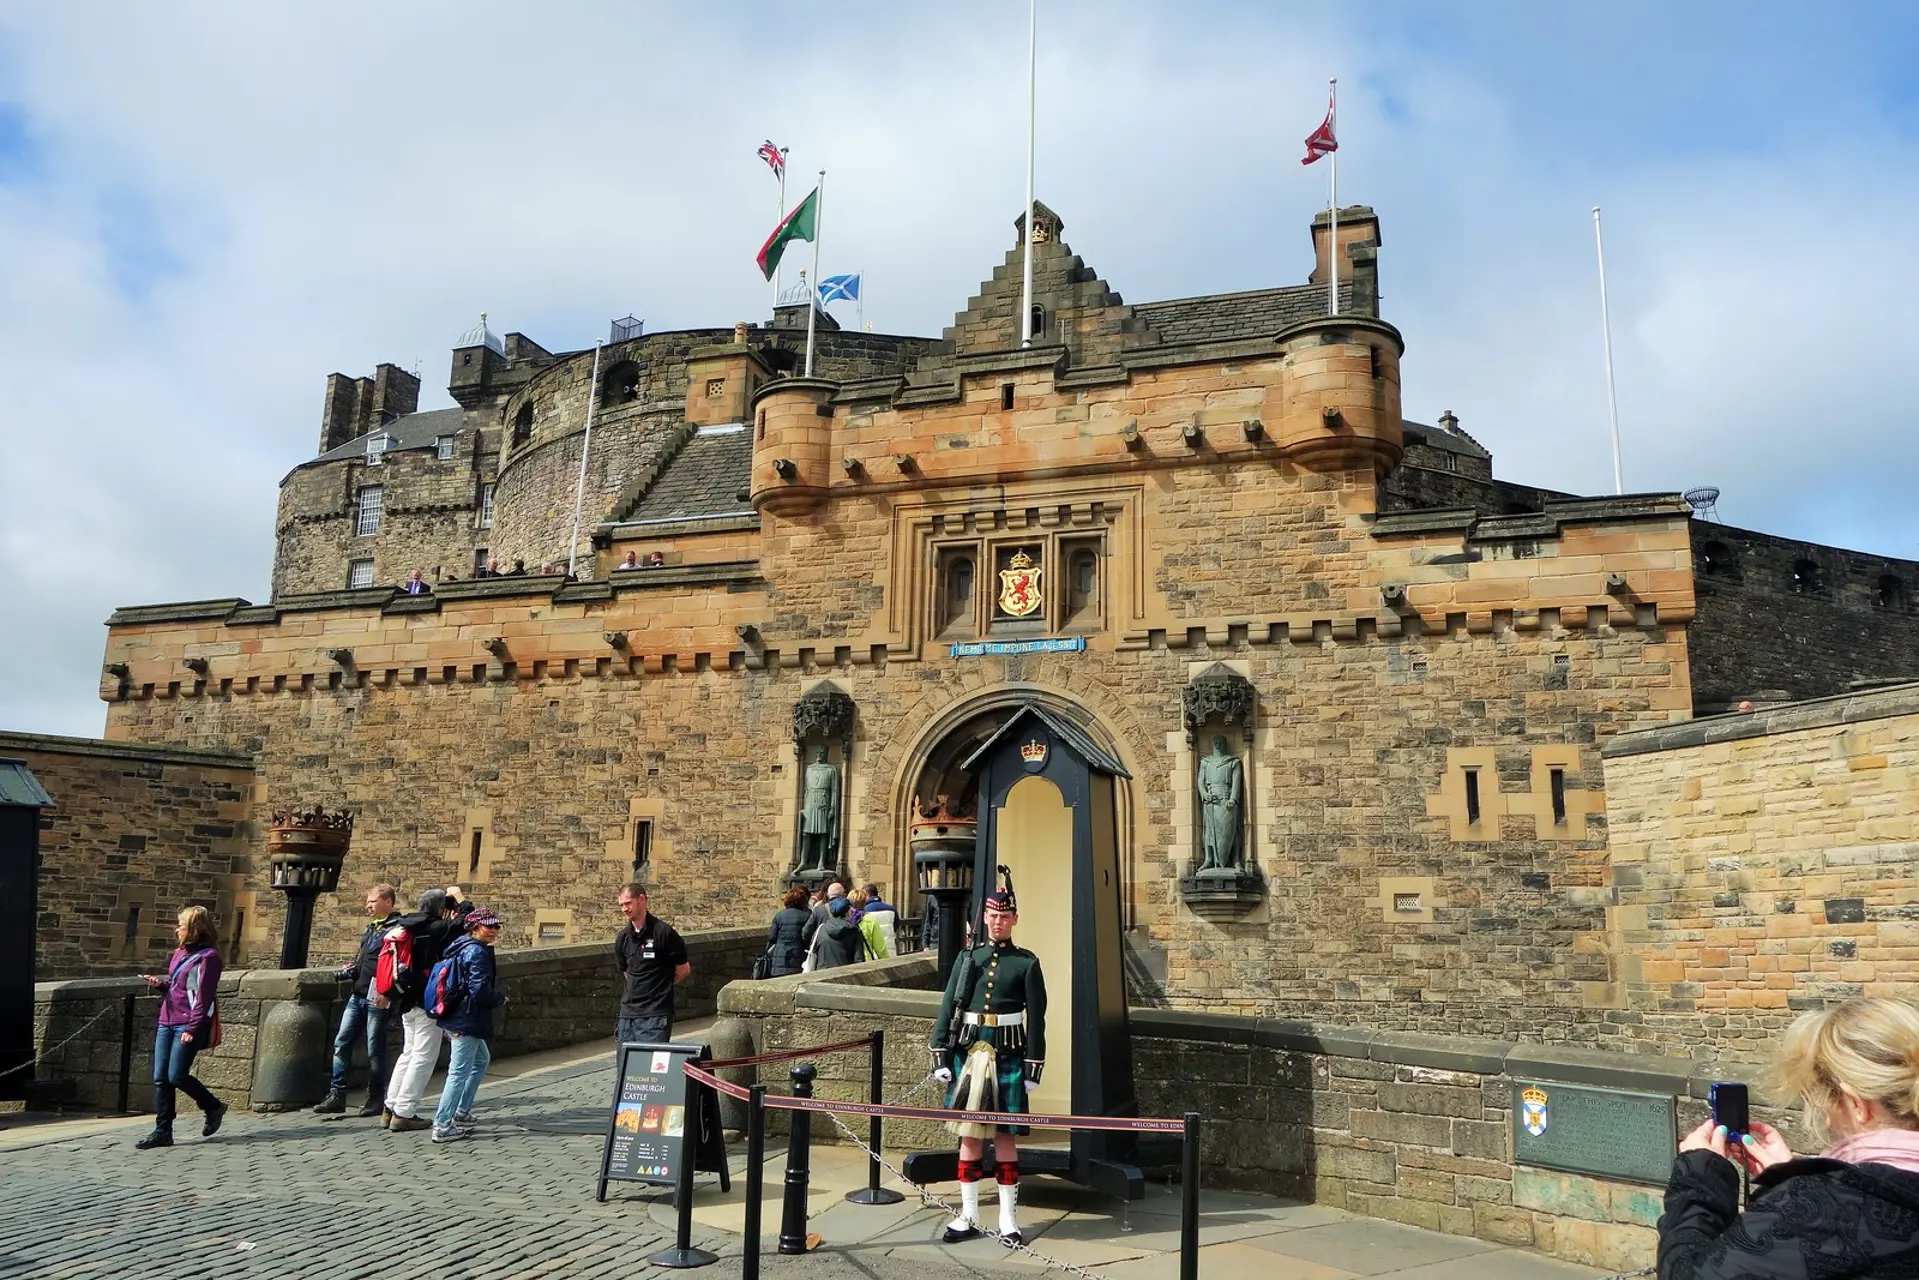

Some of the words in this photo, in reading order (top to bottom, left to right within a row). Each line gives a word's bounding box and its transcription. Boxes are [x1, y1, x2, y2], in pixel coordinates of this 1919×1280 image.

[959, 644, 983, 655] NEMO
[985, 643, 998, 653] ME
[1000, 642, 1034, 653] IMPUNE
[1038, 639, 1077, 651] LACESSIT
[625, 1082, 666, 1093] EDINBURGH
[623, 1091, 648, 1101] CASTLE
[835, 1104, 865, 1112] EDINBURGH
[1582, 1095, 1601, 1106] THIS
[1606, 1099, 1628, 1109] SPOT
[1648, 1104, 1667, 1114] 1625
